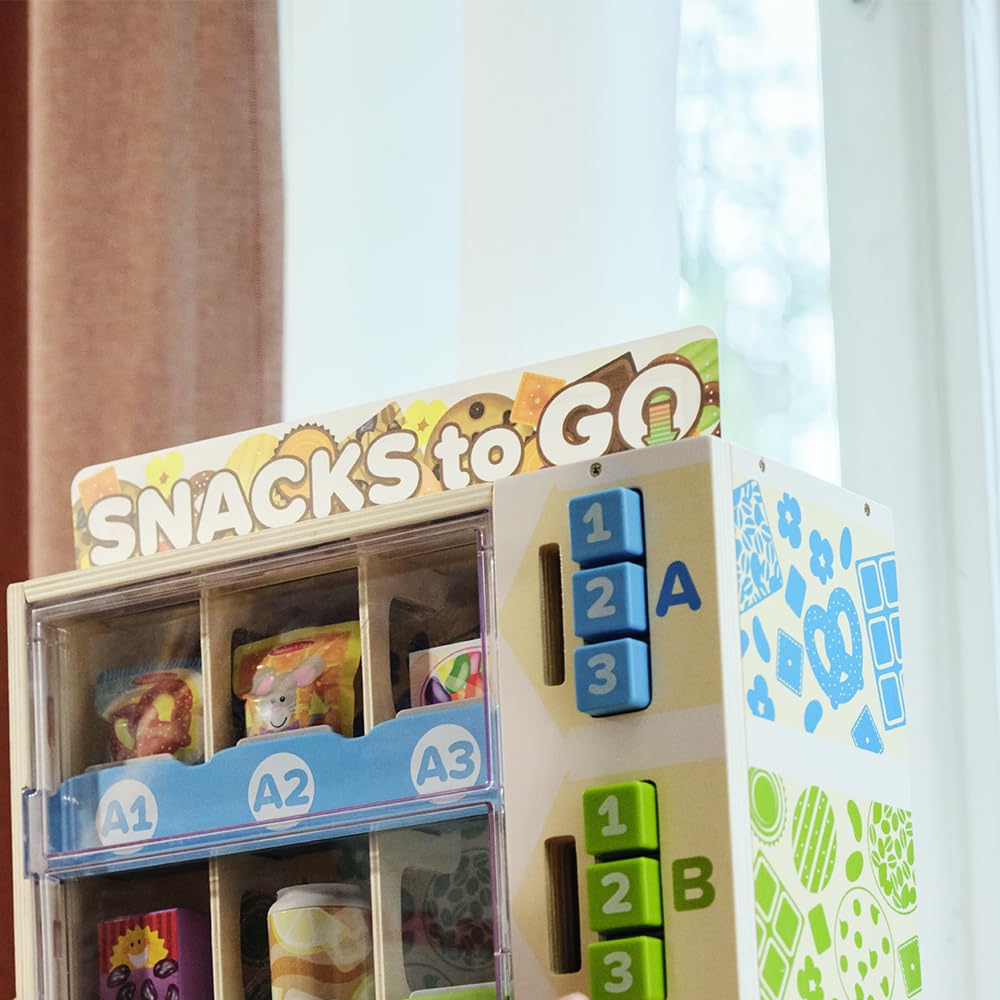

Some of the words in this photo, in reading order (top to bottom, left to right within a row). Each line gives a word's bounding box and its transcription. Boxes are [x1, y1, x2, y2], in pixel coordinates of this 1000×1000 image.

[88, 428, 419, 568] SNACKS
[433, 424, 523, 490] to
[538, 362, 702, 467] GO
[581, 502, 612, 543] 1
[584, 576, 616, 619] 2
[655, 560, 701, 617] A
[587, 653, 617, 695] 3
[416, 740, 475, 787] A3
[252, 769, 310, 813] A2
[101, 795, 154, 837] A1
[598, 795, 628, 837] 1
[601, 871, 633, 915] 2
[671, 856, 716, 912] B
[603, 951, 634, 995] 3
